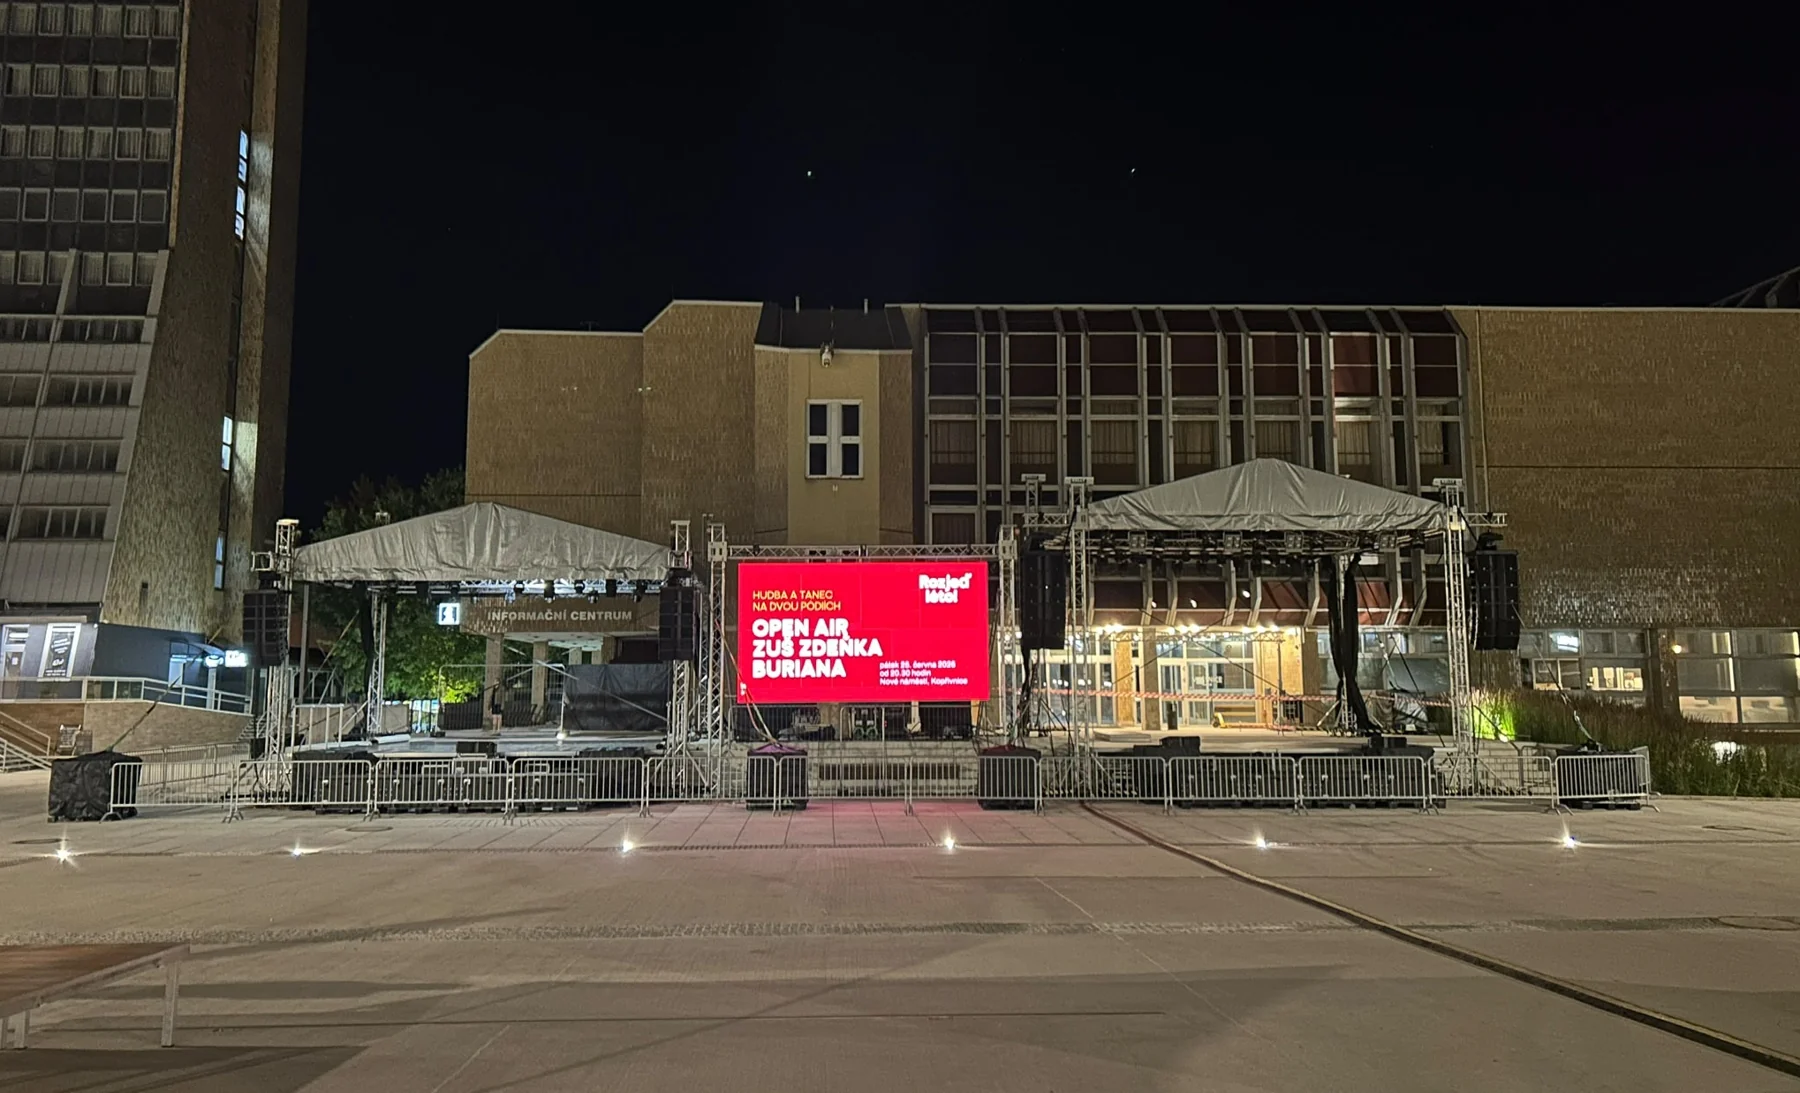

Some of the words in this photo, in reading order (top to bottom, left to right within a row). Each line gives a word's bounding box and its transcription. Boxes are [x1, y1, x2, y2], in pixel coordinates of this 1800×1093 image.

[752, 590, 788, 600] HUDBA
[790, 590, 798, 600] A
[800, 590, 833, 600] TANEC
[752, 602, 767, 611] NA
[769, 602, 799, 611] DVOU
[800, 600, 841, 611] PÓDIÍCH
[487, 609, 567, 621] INFORMAČNÍ
[570, 611, 632, 621] CENTRUM
[752, 618, 810, 637] OPEN
[814, 618, 849, 637] AIR
[752, 636, 795, 658] ZUŠ
[798, 636, 883, 658] ZDEŇKA
[752, 659, 847, 679] BURIANA
[879, 669, 889, 677] od
[911, 669, 931, 677] hodin
[879, 677, 899, 685] Nové
